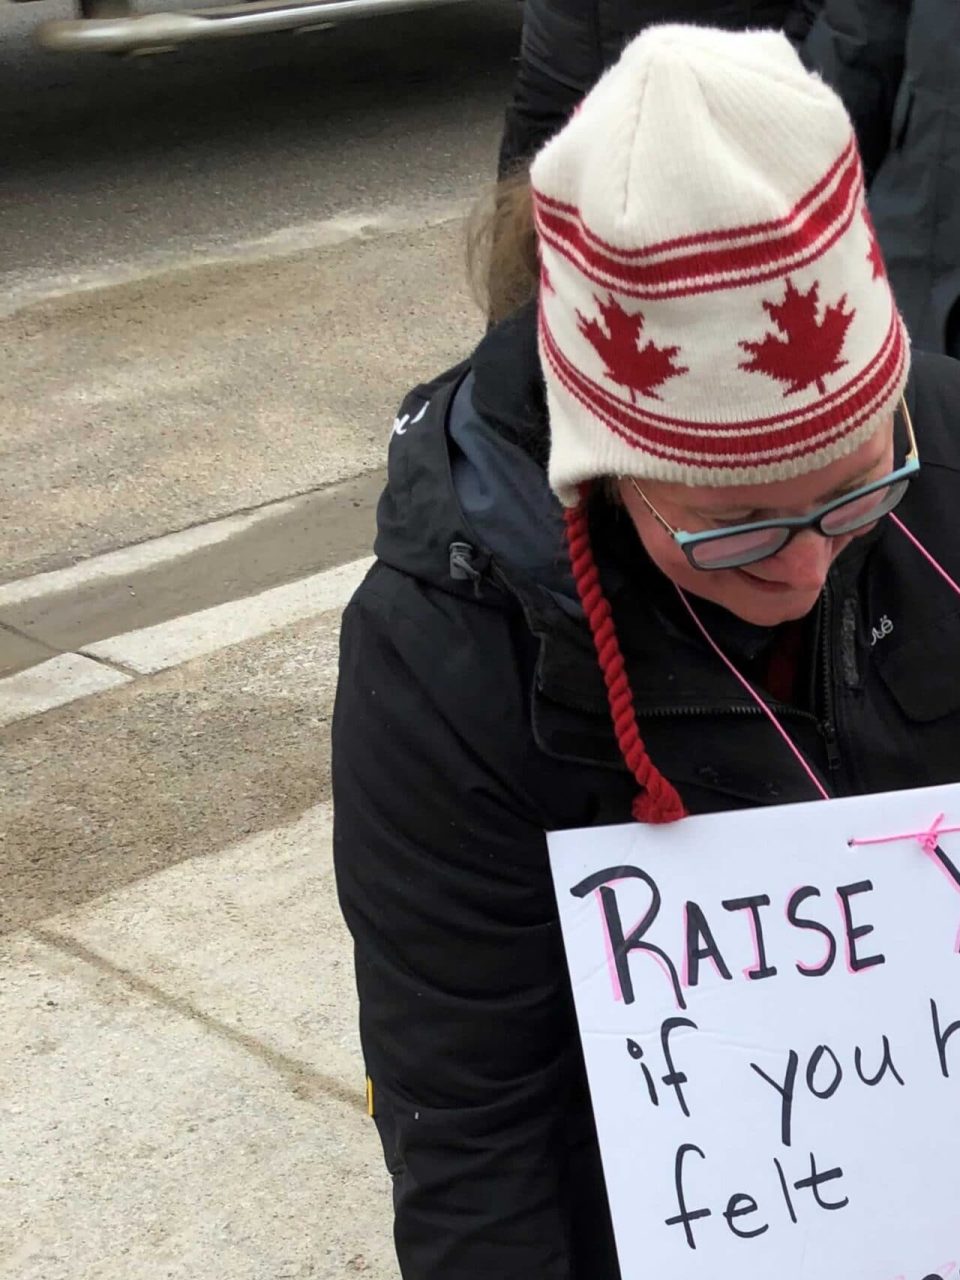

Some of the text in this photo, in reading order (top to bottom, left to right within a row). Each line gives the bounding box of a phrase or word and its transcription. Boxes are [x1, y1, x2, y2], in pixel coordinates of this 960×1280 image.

[571, 866, 885, 1009] RAISE
[627, 1016, 698, 1118] if
[751, 1036, 904, 1146] you
[665, 1143, 849, 1250] felt
